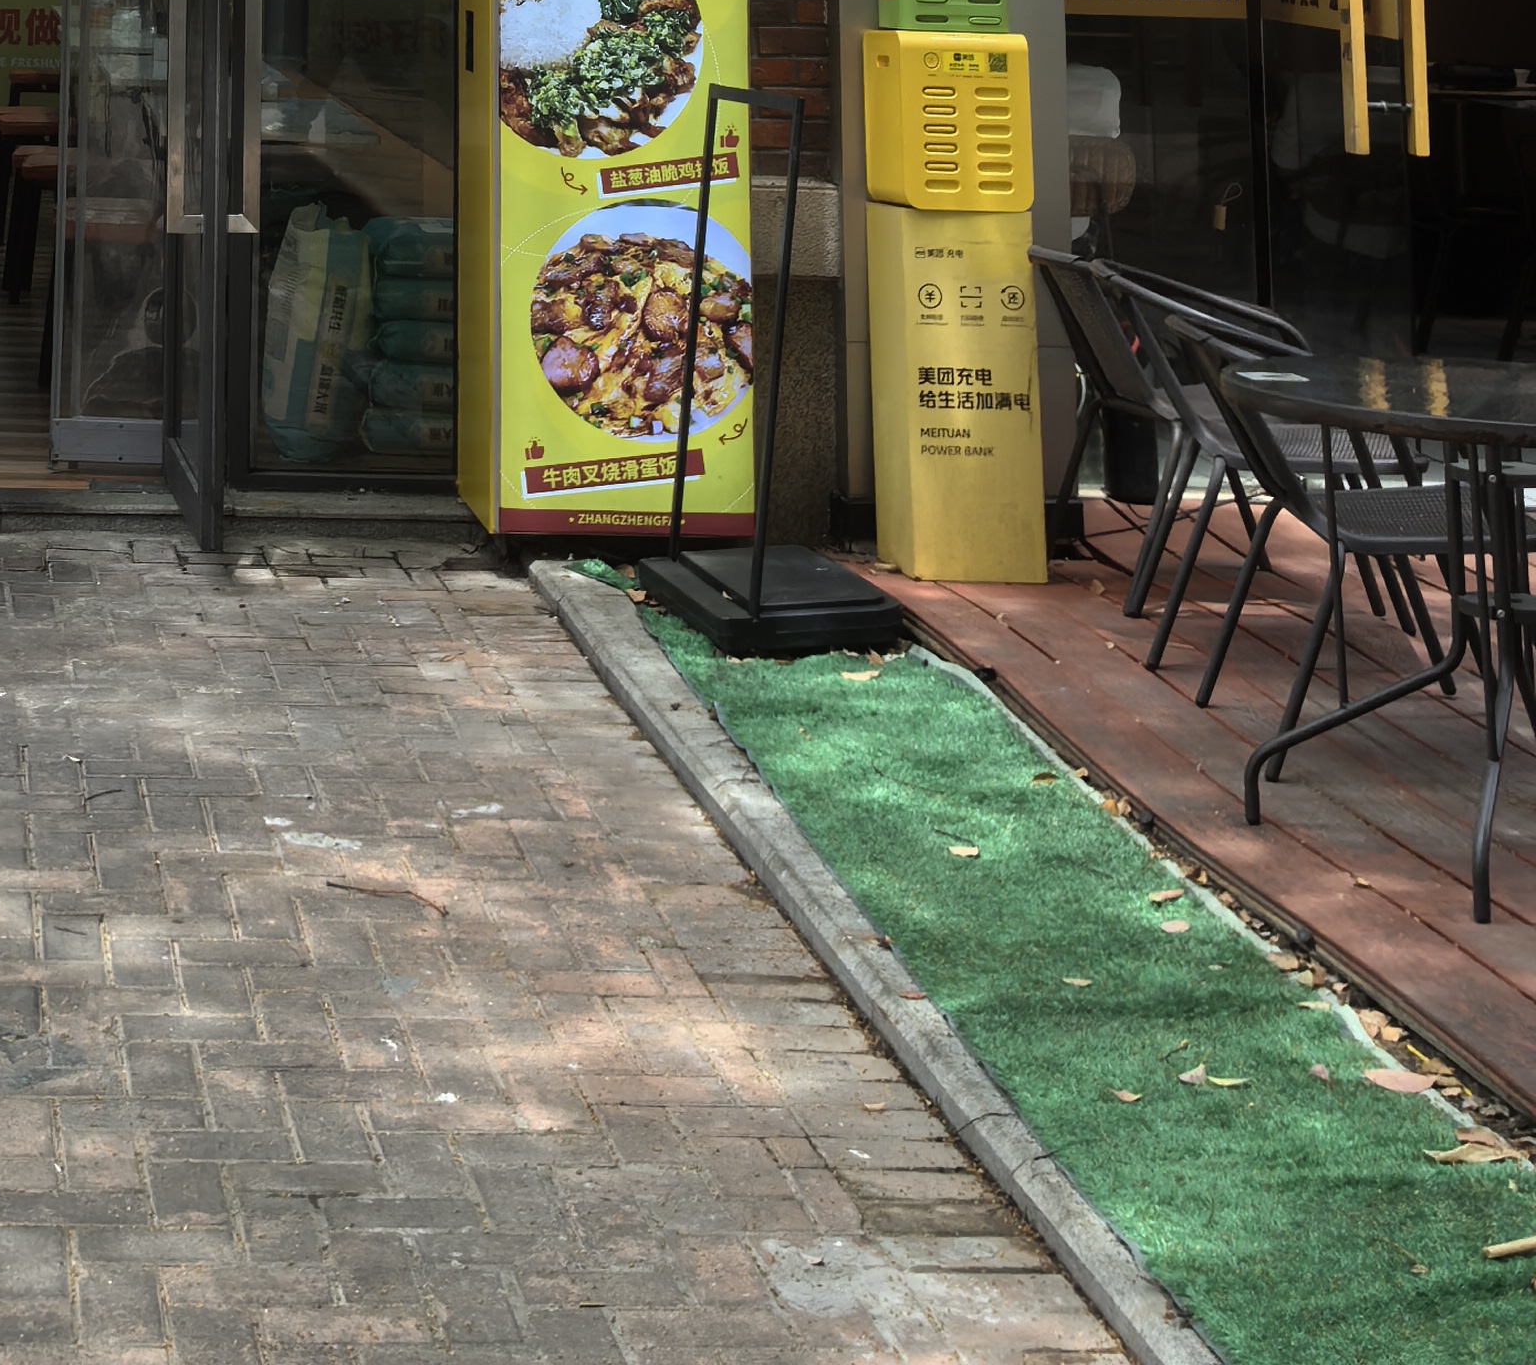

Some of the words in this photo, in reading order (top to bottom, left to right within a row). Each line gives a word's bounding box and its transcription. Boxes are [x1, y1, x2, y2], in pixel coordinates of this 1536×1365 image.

[918, 366, 993, 386] 美团充电
[918, 390, 1031, 411] 给生活加满电
[920, 427, 971, 439] MEITUAN
[921, 444, 962, 456] POWER
